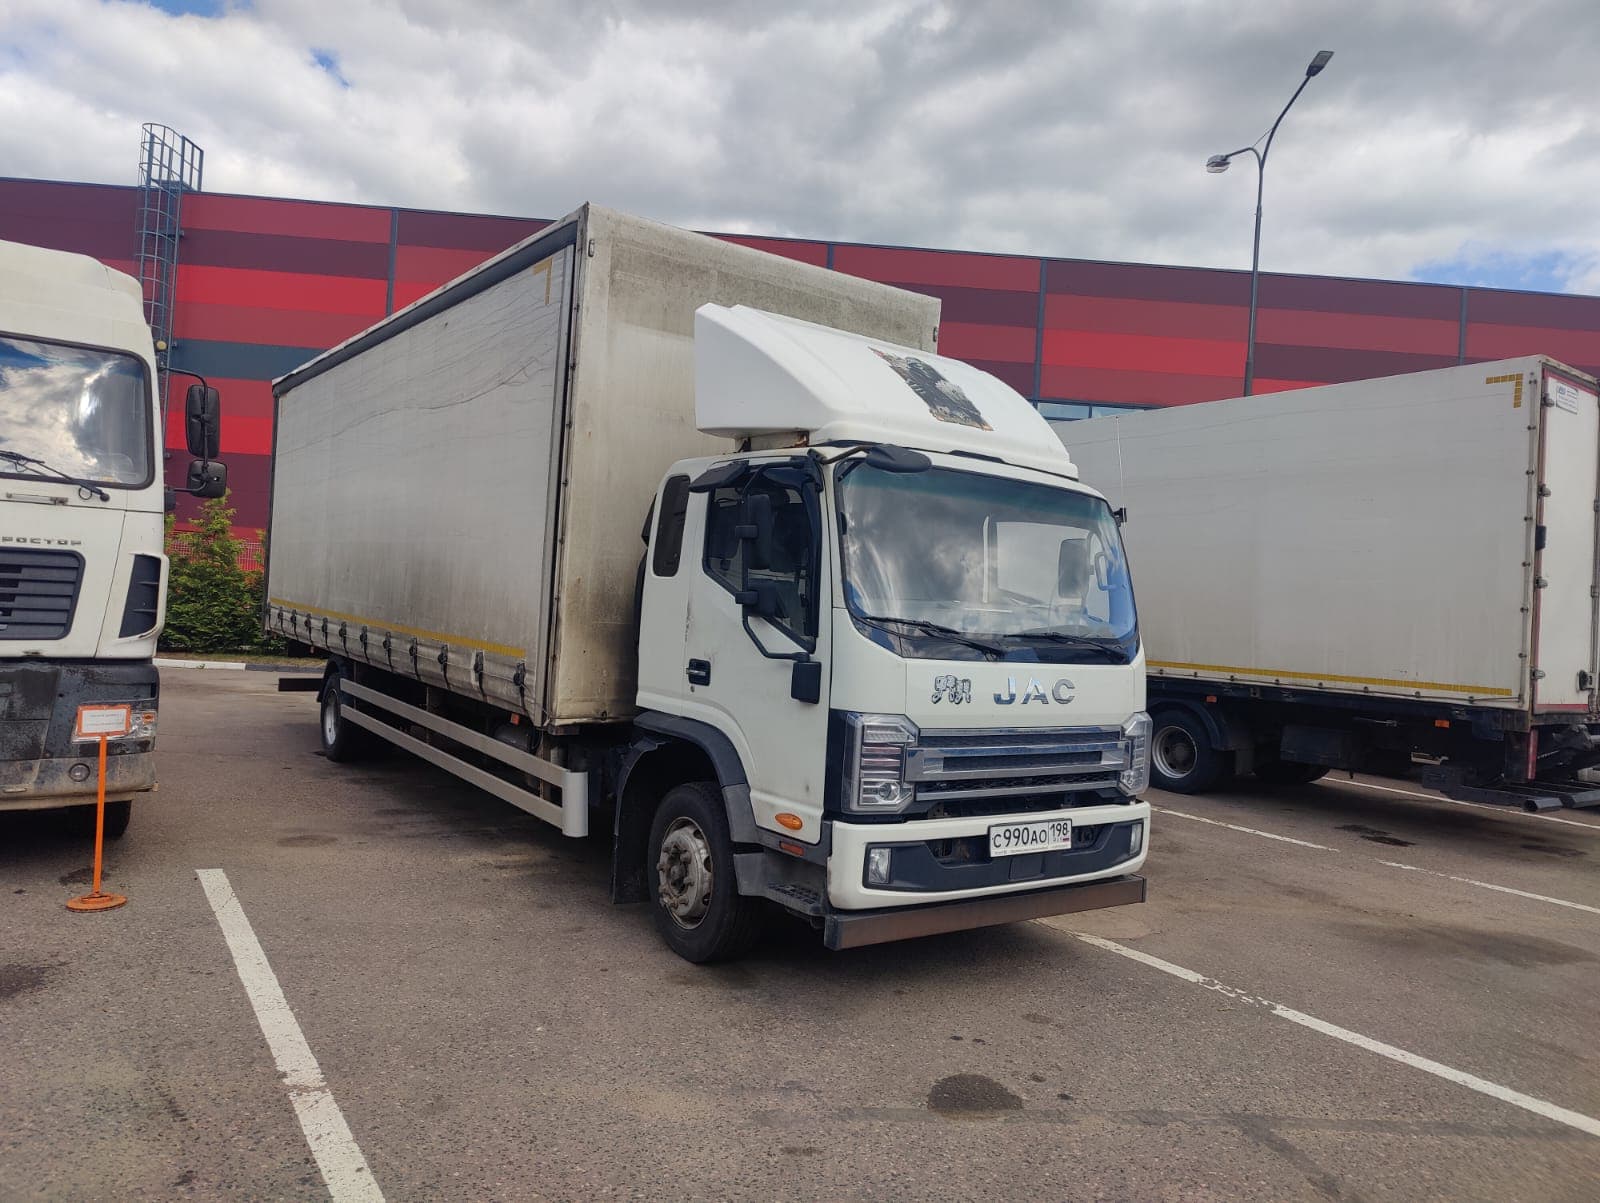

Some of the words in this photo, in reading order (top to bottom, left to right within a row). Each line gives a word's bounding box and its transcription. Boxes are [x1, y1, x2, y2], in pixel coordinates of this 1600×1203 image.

[993, 675, 1075, 704] JAC
[993, 827, 1048, 848] С990АО
[1050, 822, 1069, 838] 198
